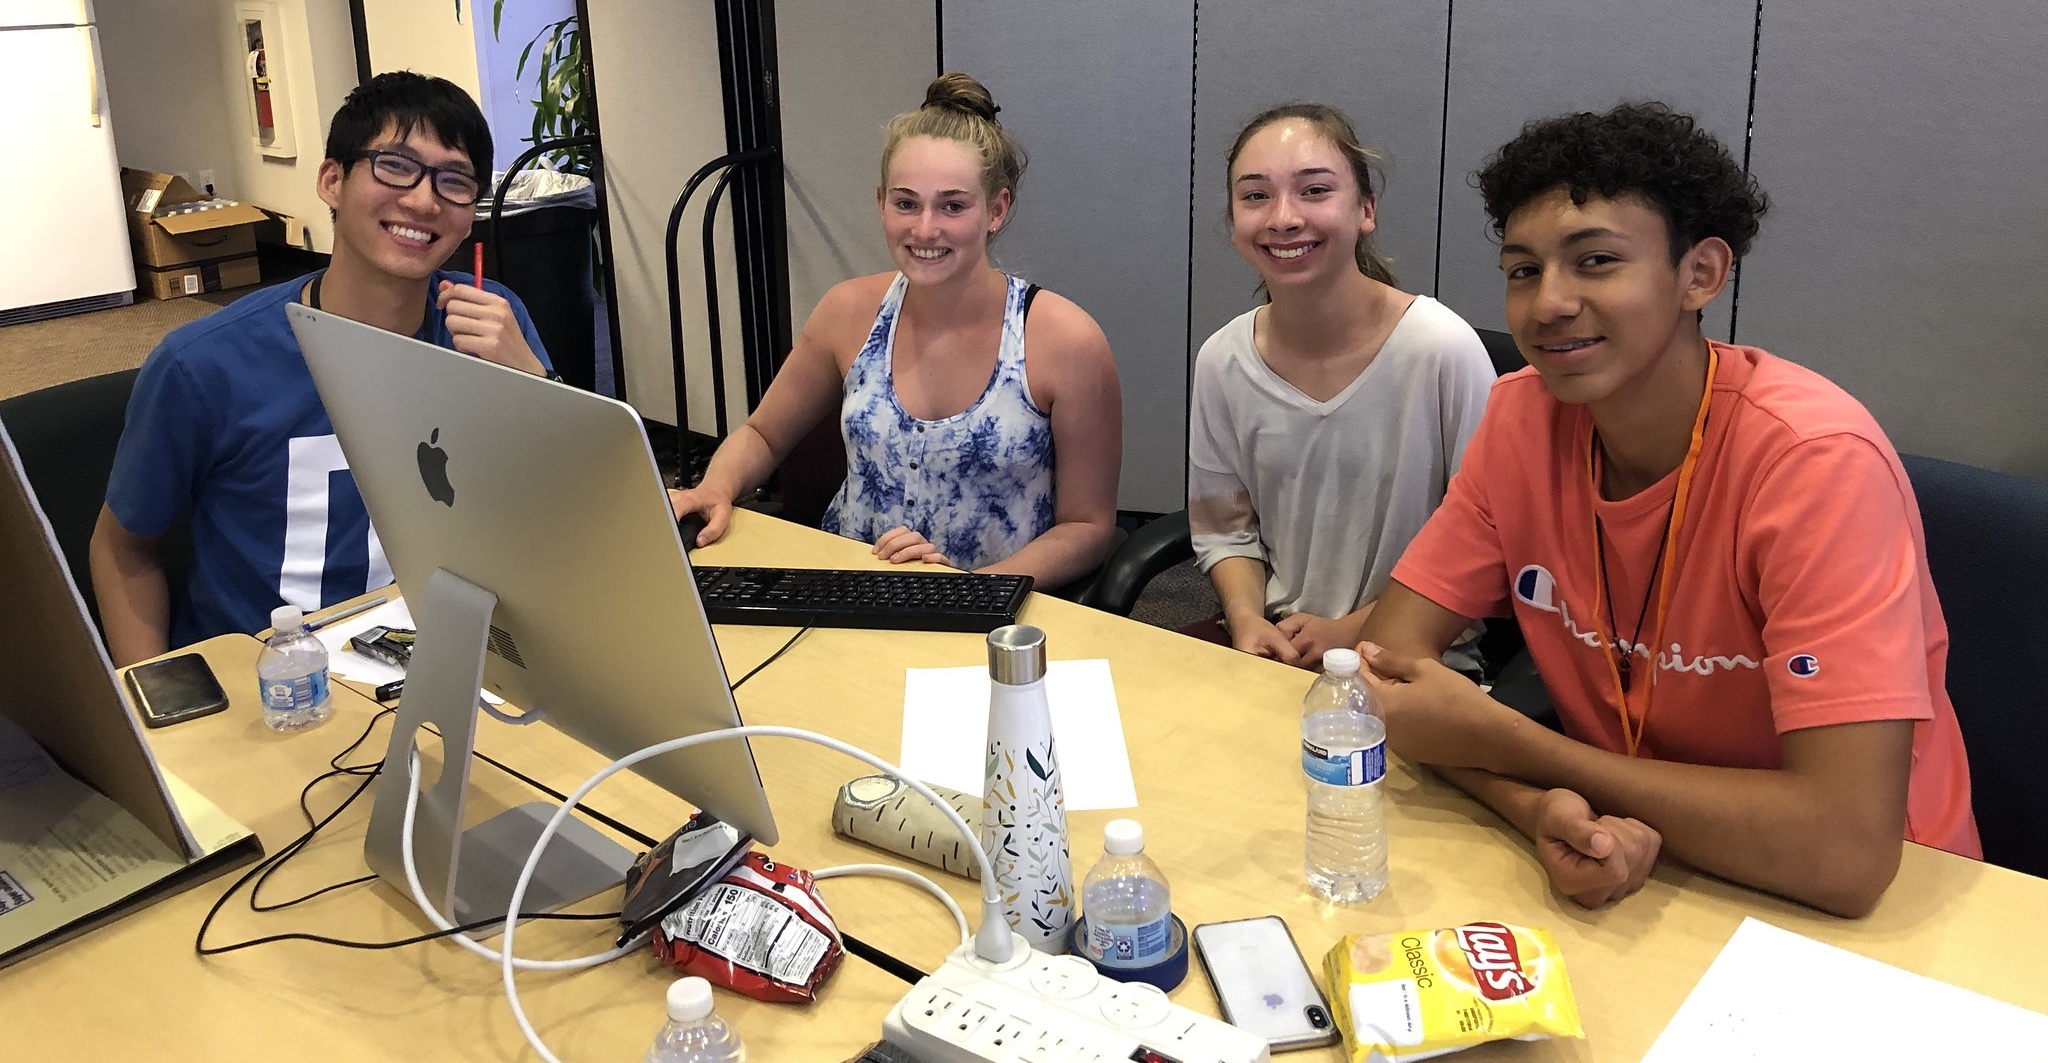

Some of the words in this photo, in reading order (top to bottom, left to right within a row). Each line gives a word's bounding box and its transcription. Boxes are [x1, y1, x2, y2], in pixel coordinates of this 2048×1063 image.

[725, 889, 738, 905] 150
[1401, 937, 1433, 989] Classic
[1455, 925, 1528, 992] Lay's
